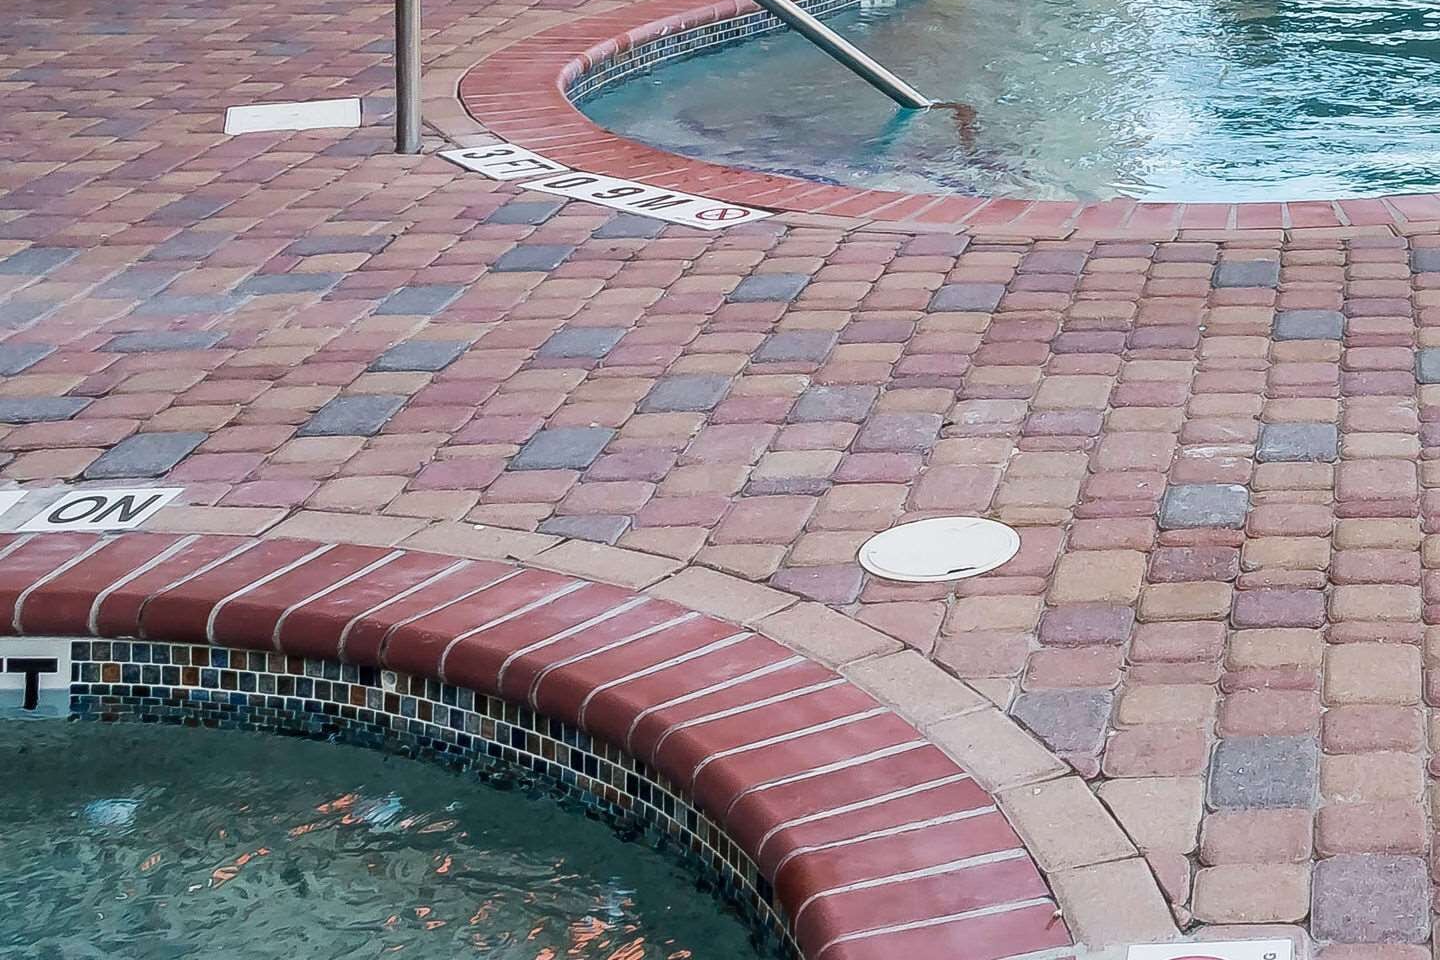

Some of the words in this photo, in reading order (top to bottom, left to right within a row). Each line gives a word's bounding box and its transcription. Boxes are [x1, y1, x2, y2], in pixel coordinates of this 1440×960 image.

[461, 148, 515, 160] 3
[483, 158, 556, 174] FT
[626, 194, 694, 211] M
